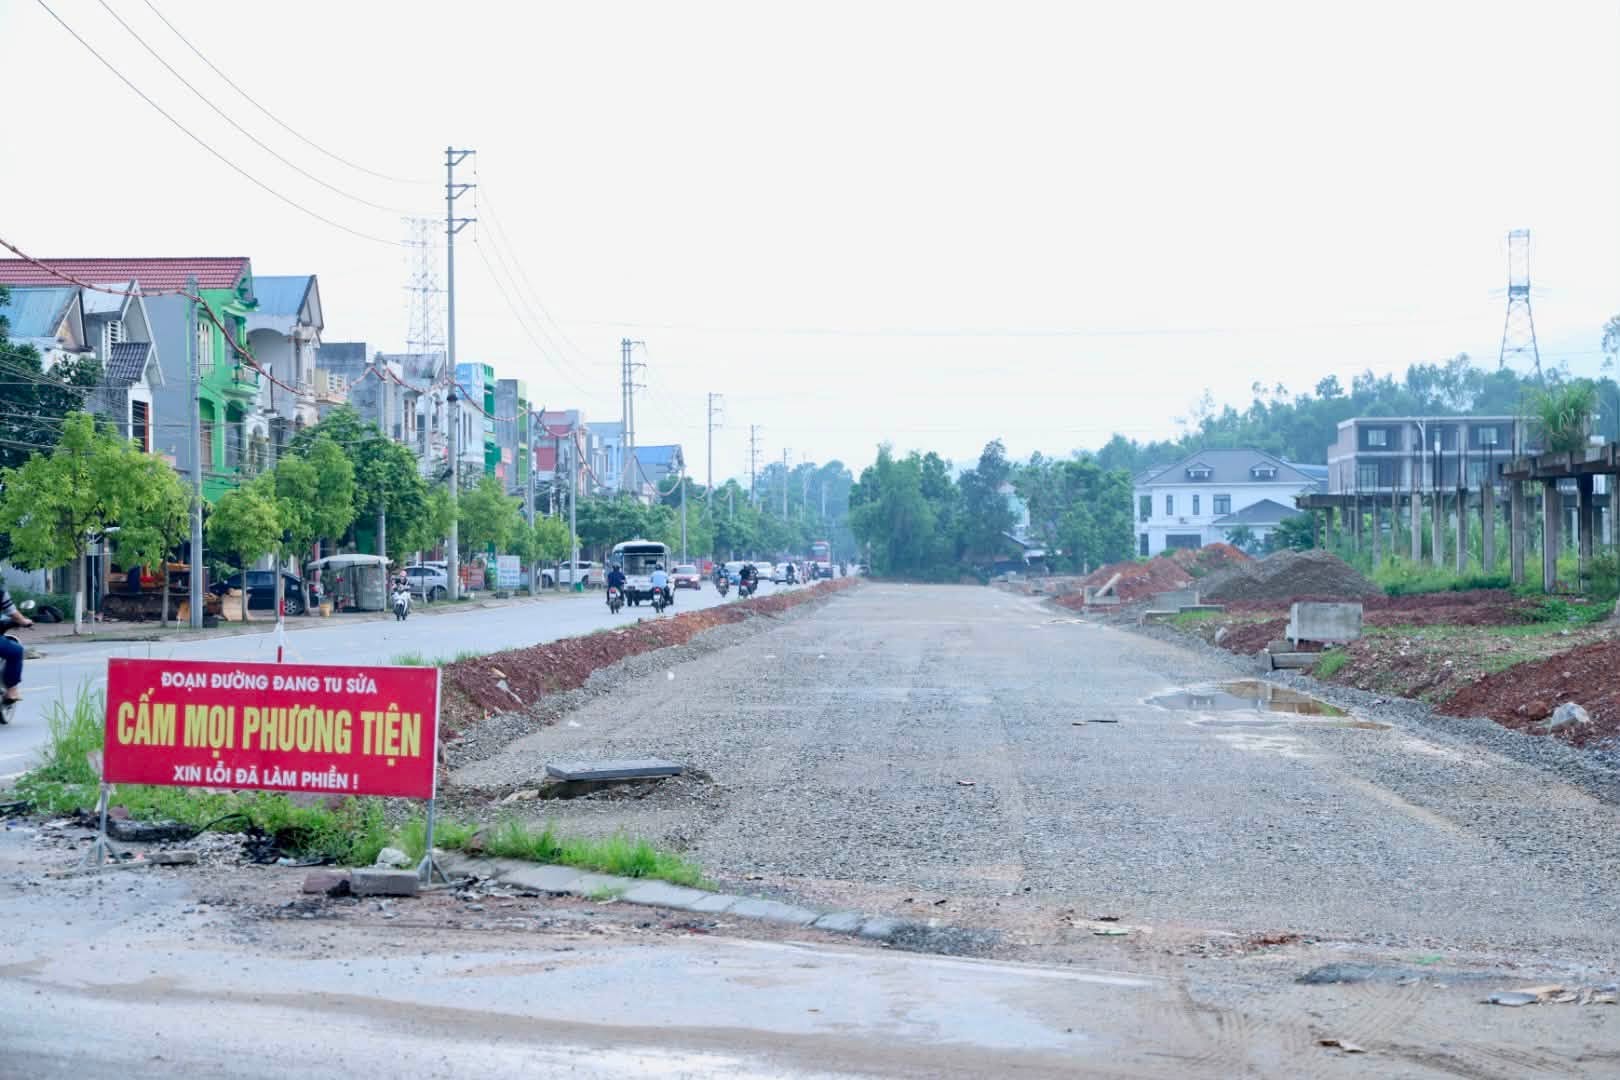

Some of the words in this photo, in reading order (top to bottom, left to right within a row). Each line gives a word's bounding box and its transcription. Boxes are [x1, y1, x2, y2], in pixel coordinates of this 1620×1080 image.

[160, 671, 207, 693] ĐOẠN
[210, 669, 269, 691] ĐƯỜNG
[272, 675, 320, 693] ĐANG
[324, 676, 343, 694] TU
[346, 672, 378, 695] SỬA
[117, 687, 177, 748] CẤM
[183, 704, 234, 759] MỌI
[242, 703, 352, 754] PHƯƠNG
[360, 702, 422, 766] TIỆN
[173, 765, 202, 782] XIN
[205, 759, 232, 784] LỖI
[235, 764, 259, 785] ĐÃ
[263, 762, 297, 787] LÀM
[301, 762, 349, 790] PHIỀN
